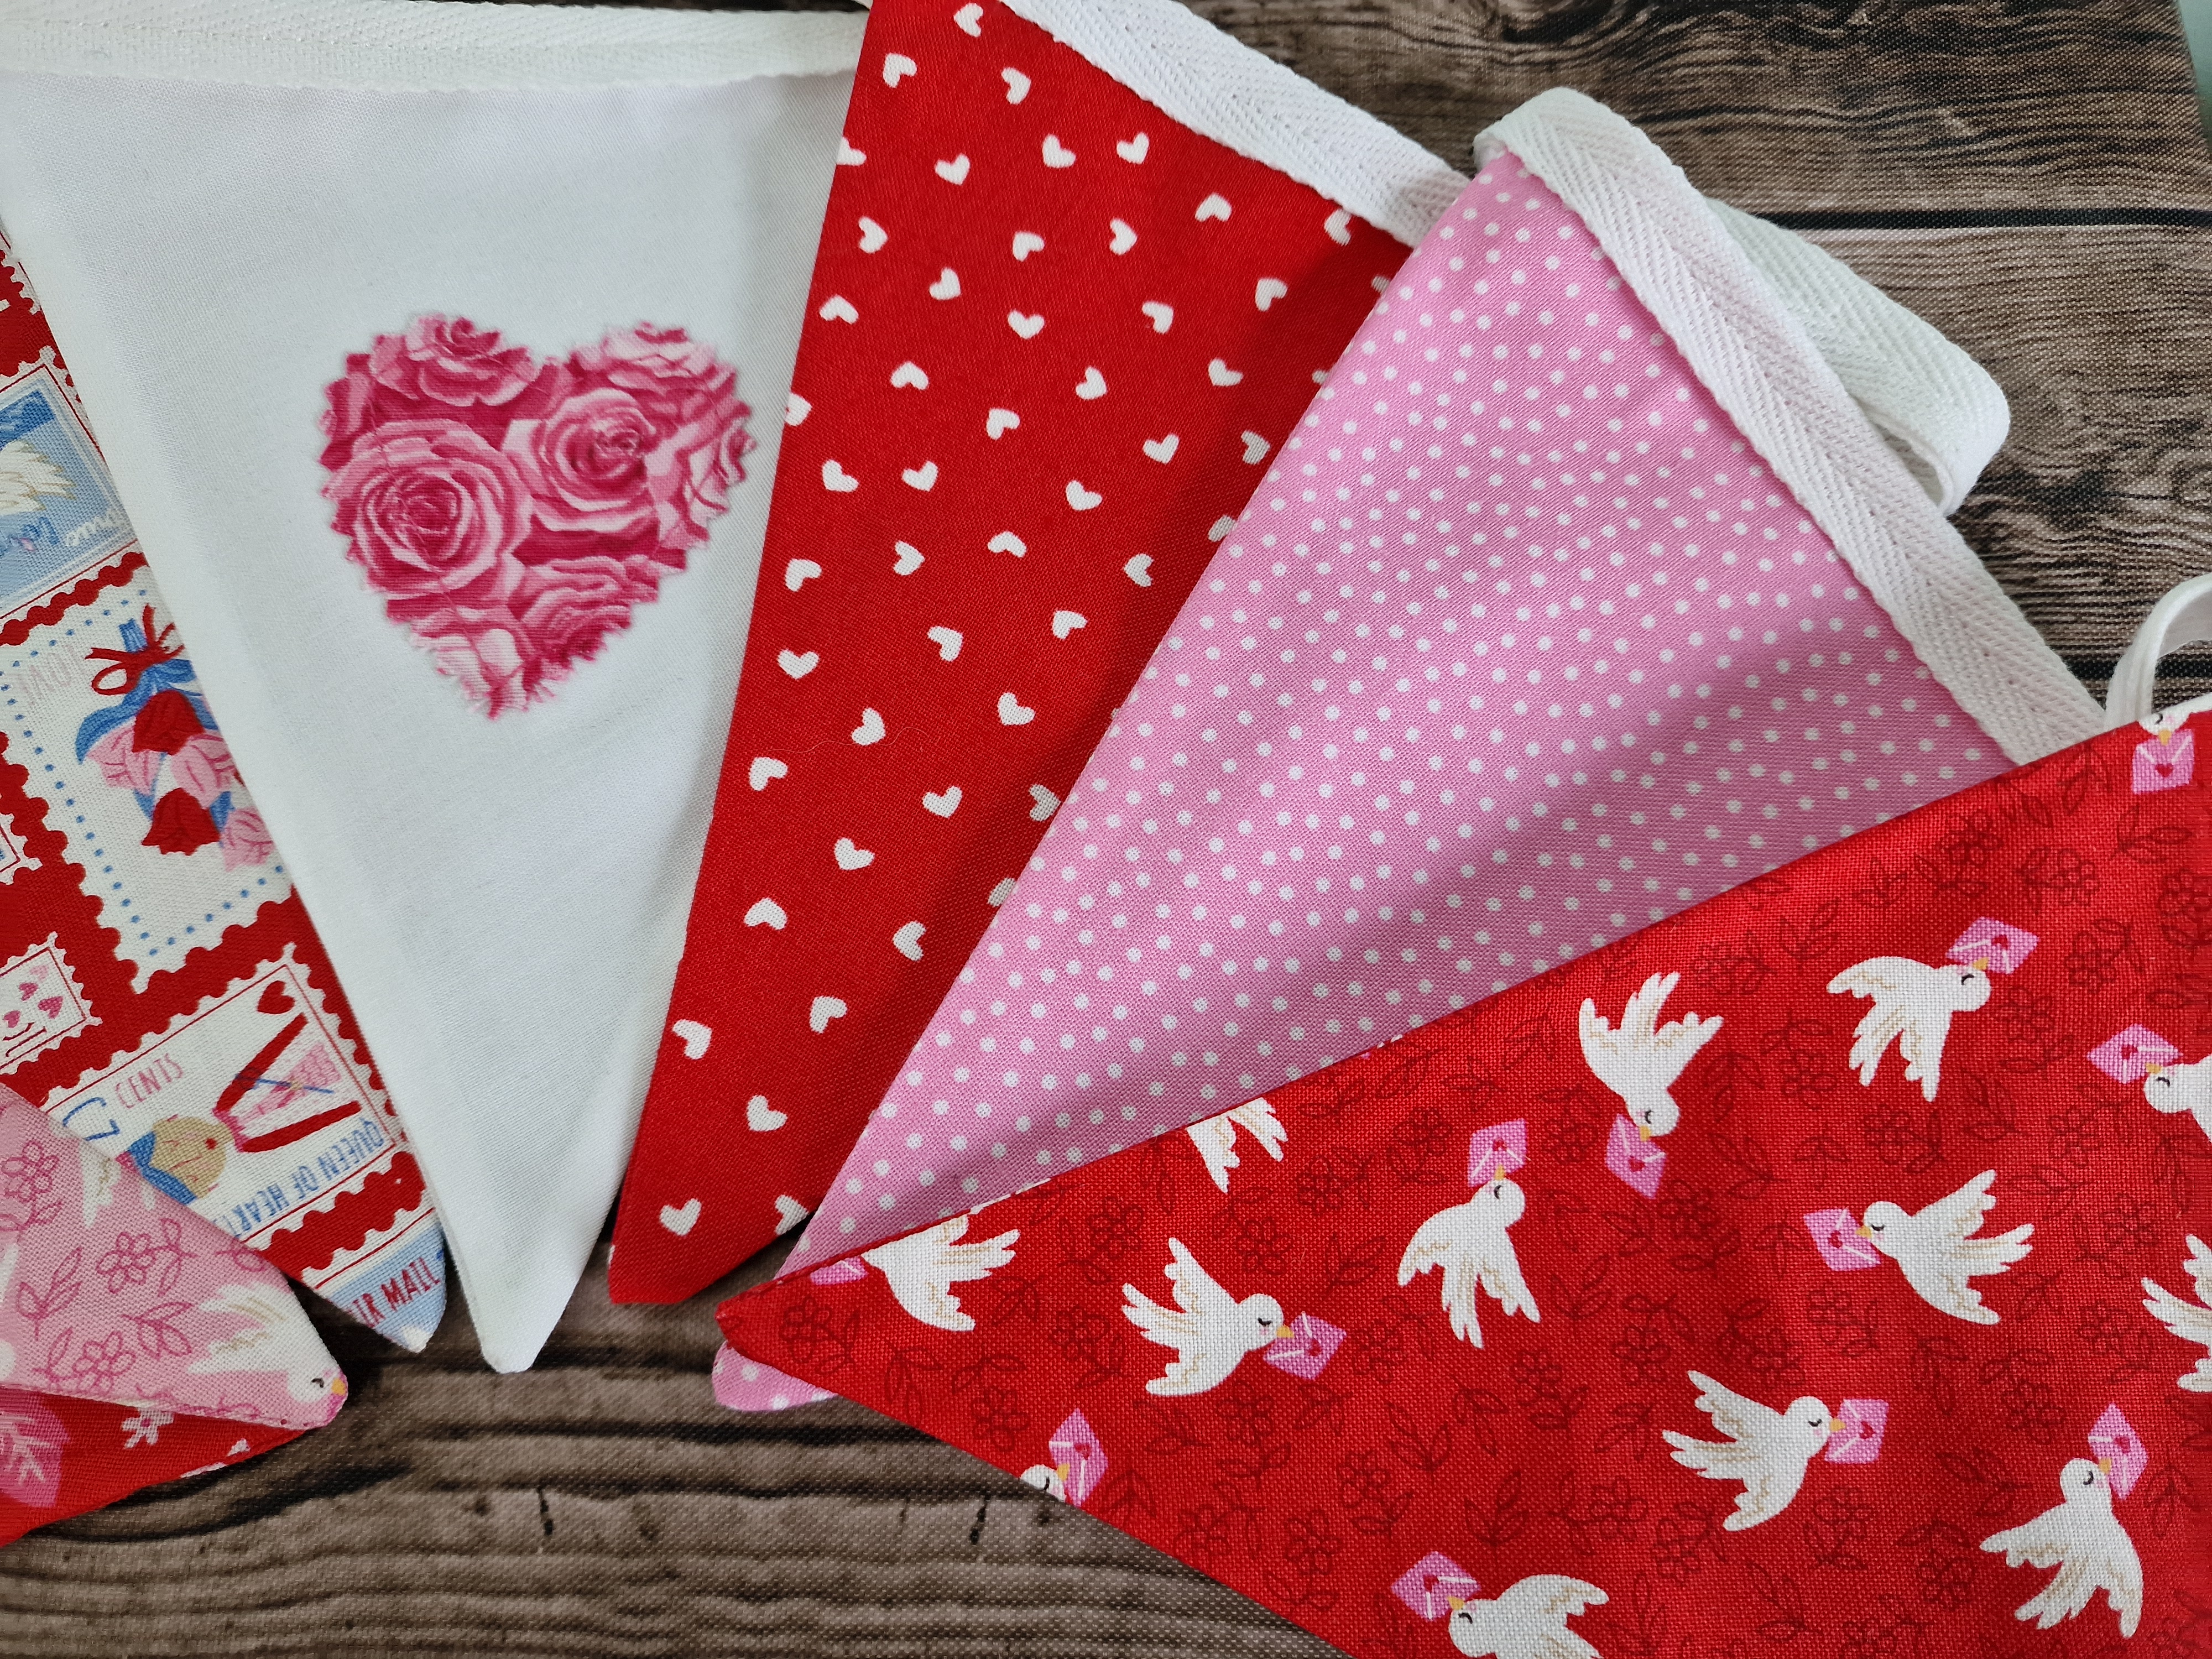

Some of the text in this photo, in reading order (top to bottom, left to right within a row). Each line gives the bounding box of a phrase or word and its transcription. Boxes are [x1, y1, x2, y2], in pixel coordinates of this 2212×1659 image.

[115, 1053, 184, 1108] CENTS
[213, 1118, 385, 1238] QUEEN OF HEART
[345, 1256, 441, 1328] IR MAIL
